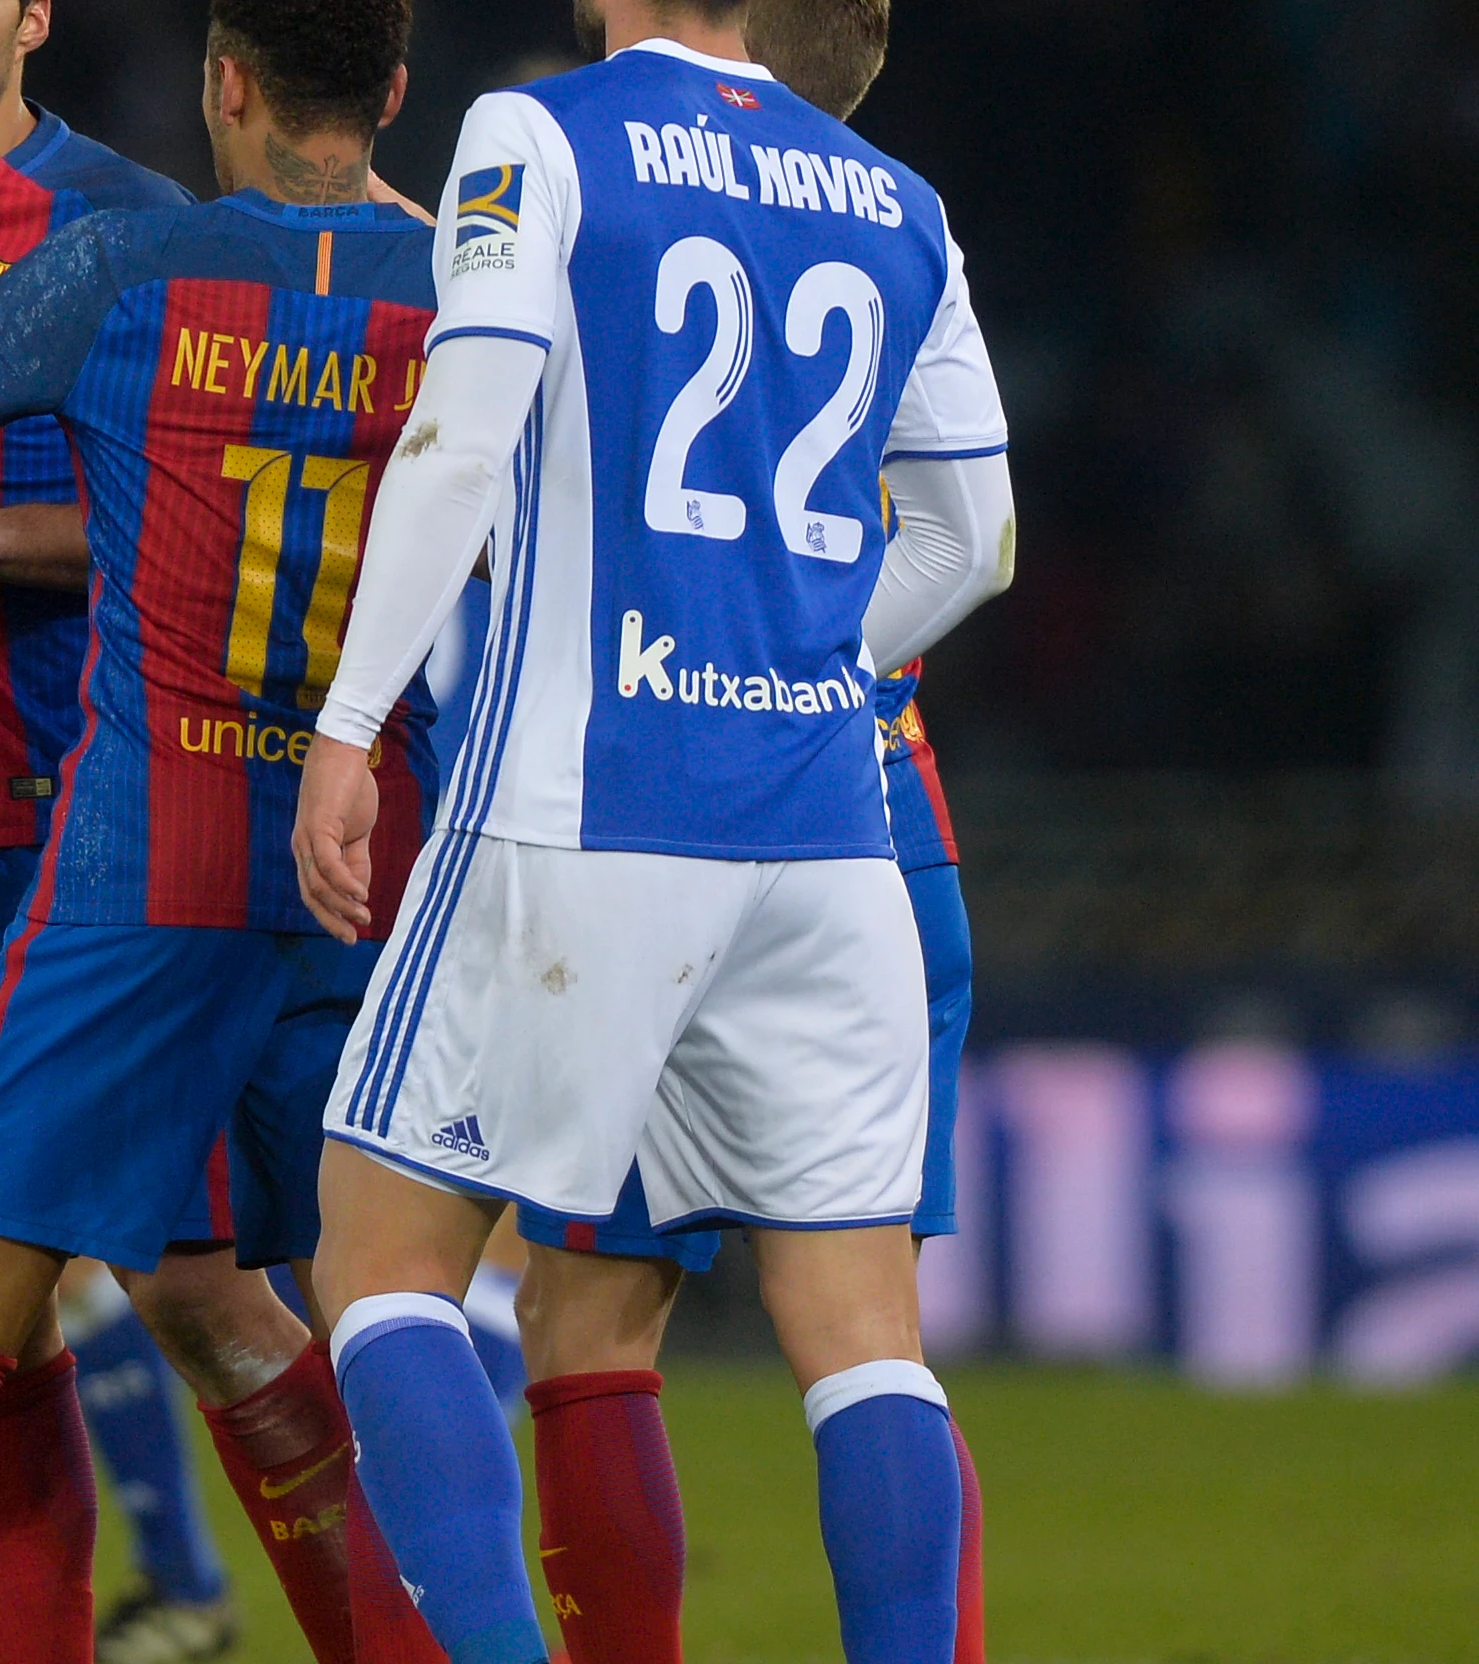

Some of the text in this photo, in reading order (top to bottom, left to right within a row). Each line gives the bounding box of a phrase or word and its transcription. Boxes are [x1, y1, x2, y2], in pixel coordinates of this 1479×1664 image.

[623, 103, 904, 229] RAÚL NAVAS
[451, 242, 516, 270] REALE
[171, 327, 428, 414] NEYMAR J
[643, 235, 885, 565] 22
[220, 443, 371, 710] 11
[180, 710, 316, 766] unice
[431, 1131, 490, 1161] adidas
